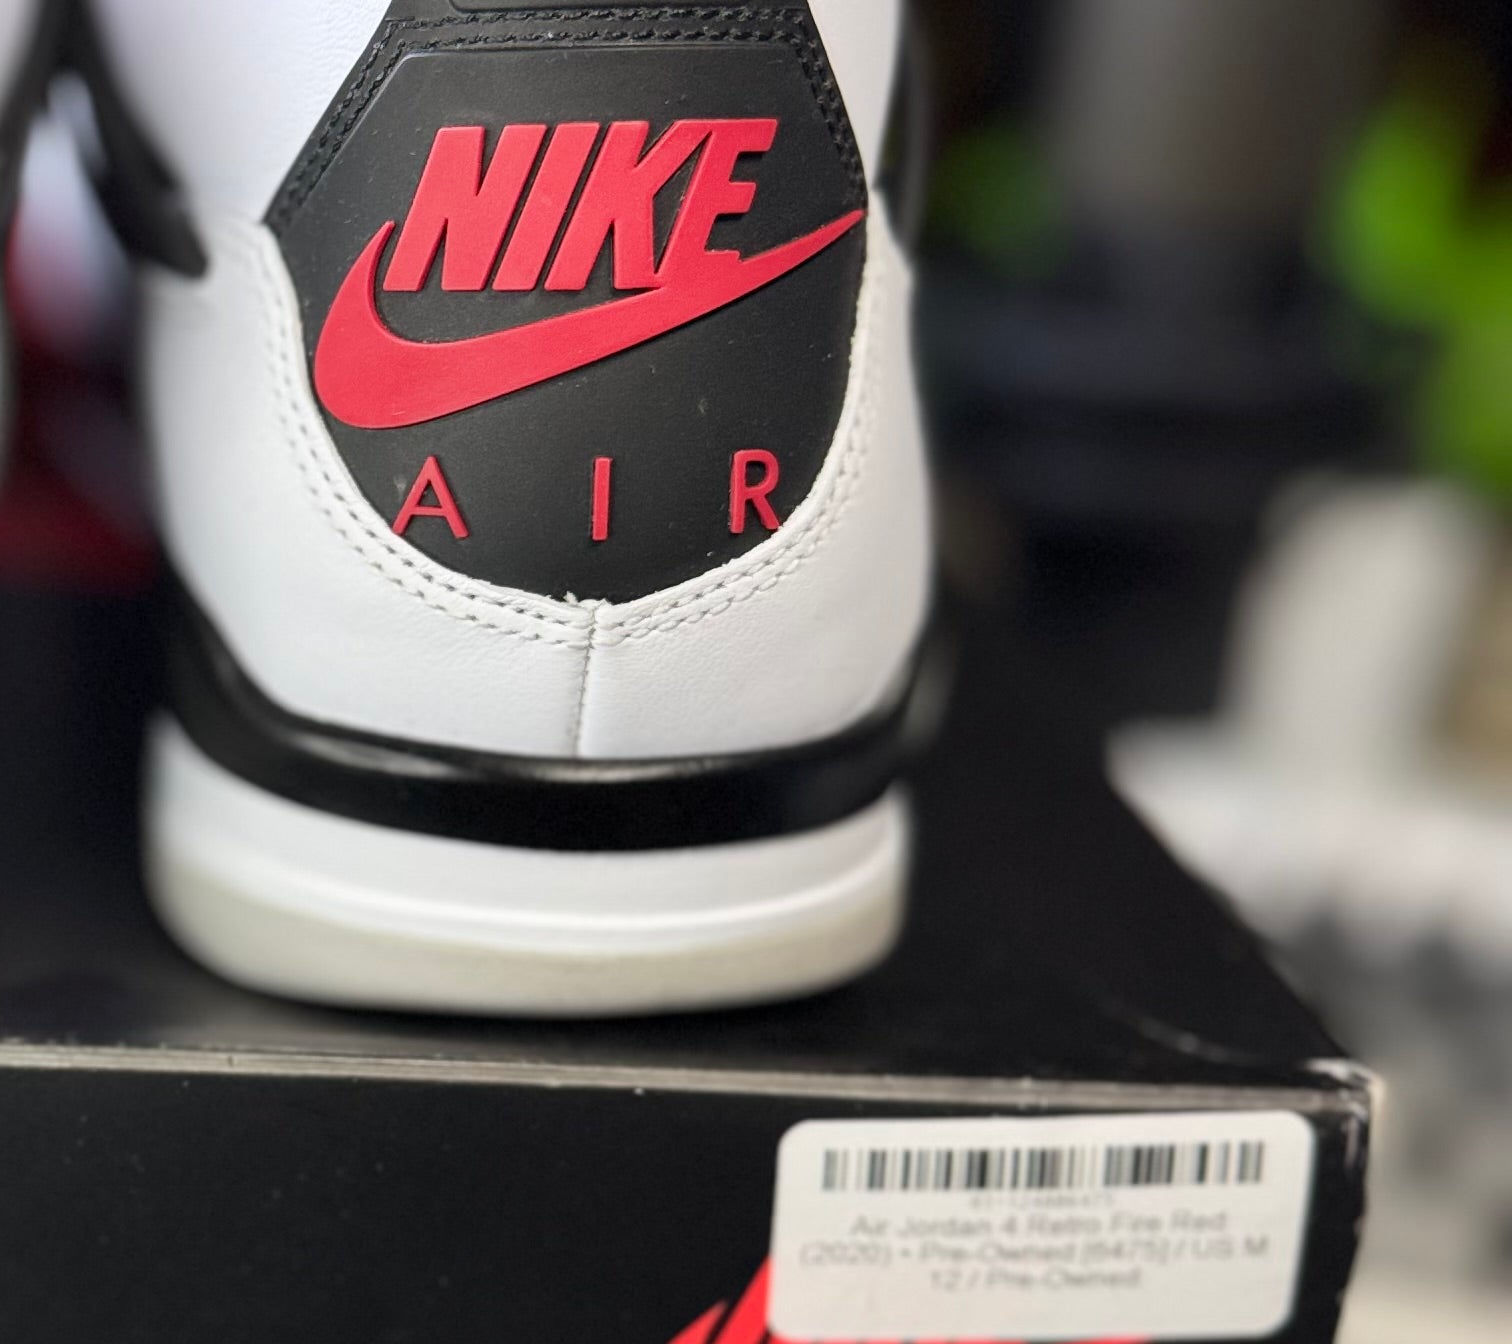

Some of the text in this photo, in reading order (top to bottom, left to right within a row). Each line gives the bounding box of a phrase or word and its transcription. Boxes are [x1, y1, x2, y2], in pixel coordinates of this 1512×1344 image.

[384, 119, 777, 290] NIKE
[392, 450, 781, 541] AIR
[850, 1208, 1228, 1237] Air Jordan 4 Retro Fire Red
[918, 1239, 1076, 1263] Pre-Owned
[1243, 1233, 1270, 1258] M
[985, 1265, 1142, 1290] Pre-Owned
